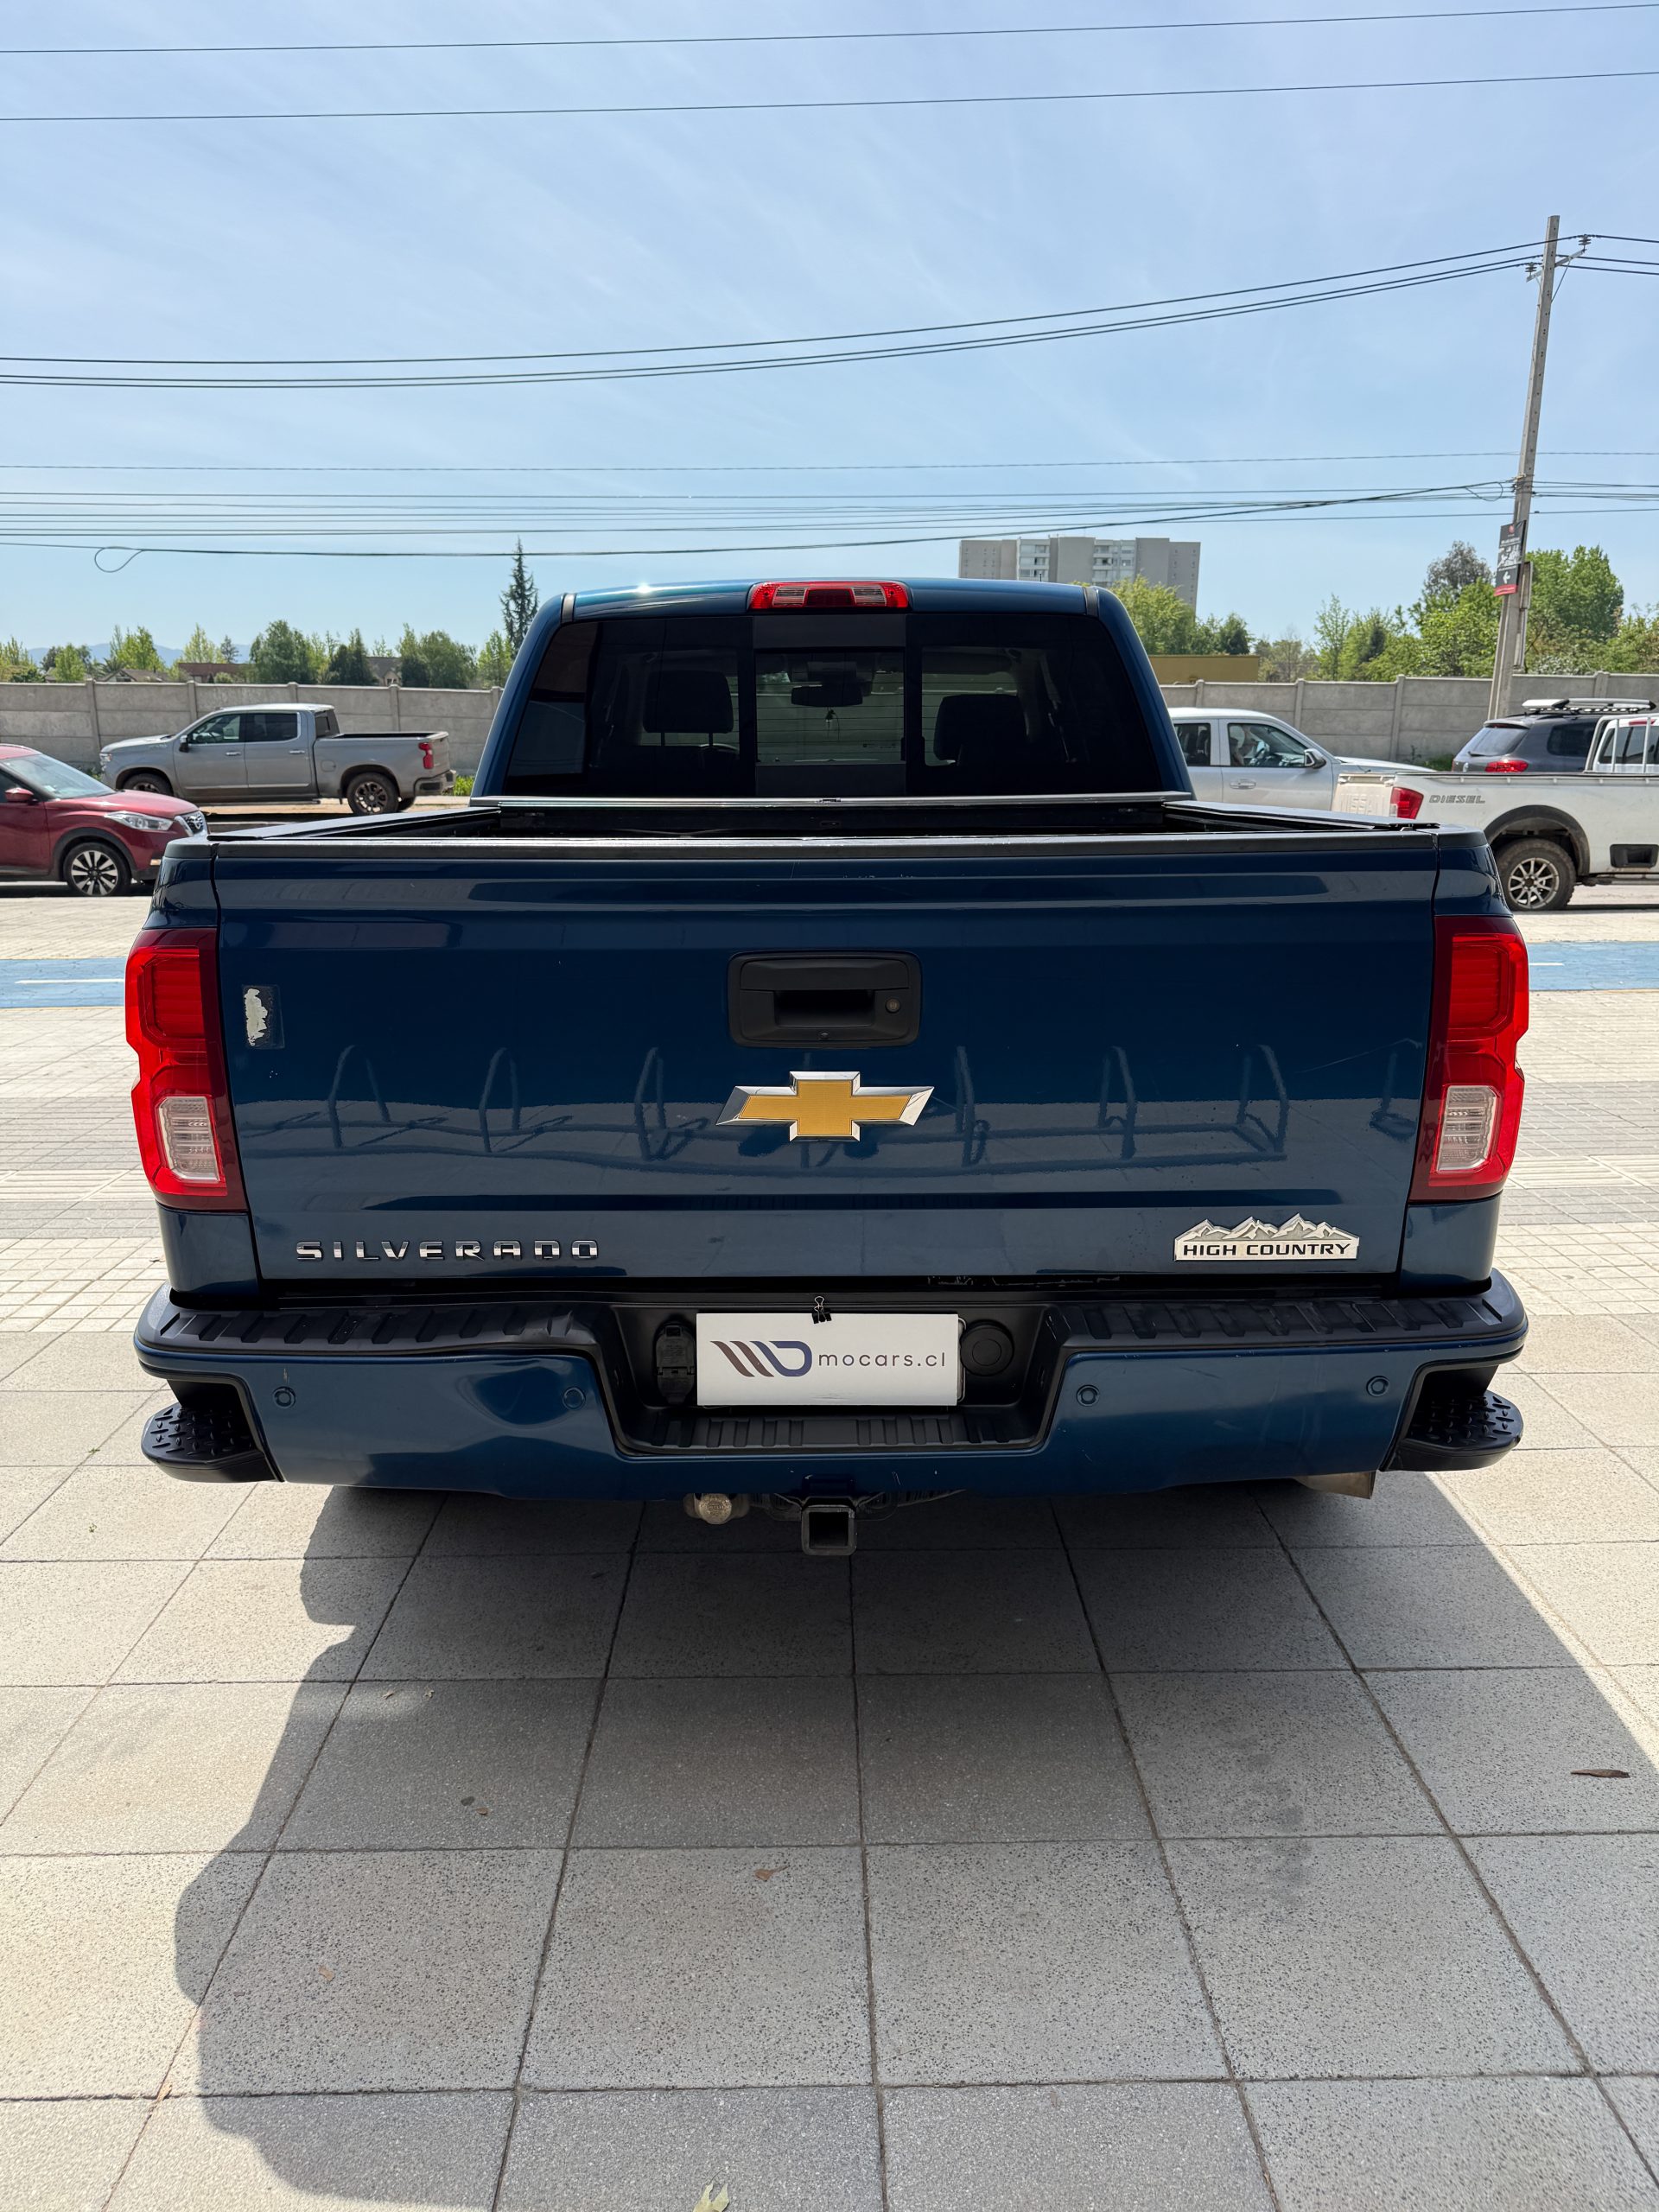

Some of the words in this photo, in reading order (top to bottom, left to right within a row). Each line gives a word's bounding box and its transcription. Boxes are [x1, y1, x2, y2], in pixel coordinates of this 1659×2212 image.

[1429, 795, 1485, 804] DIESEL
[296, 1240, 599, 1262] SILVERADO
[1183, 1244, 1236, 1256] HIGH
[1246, 1243, 1351, 1255] COUNTRY
[818, 1351, 945, 1367] mocars.cl
